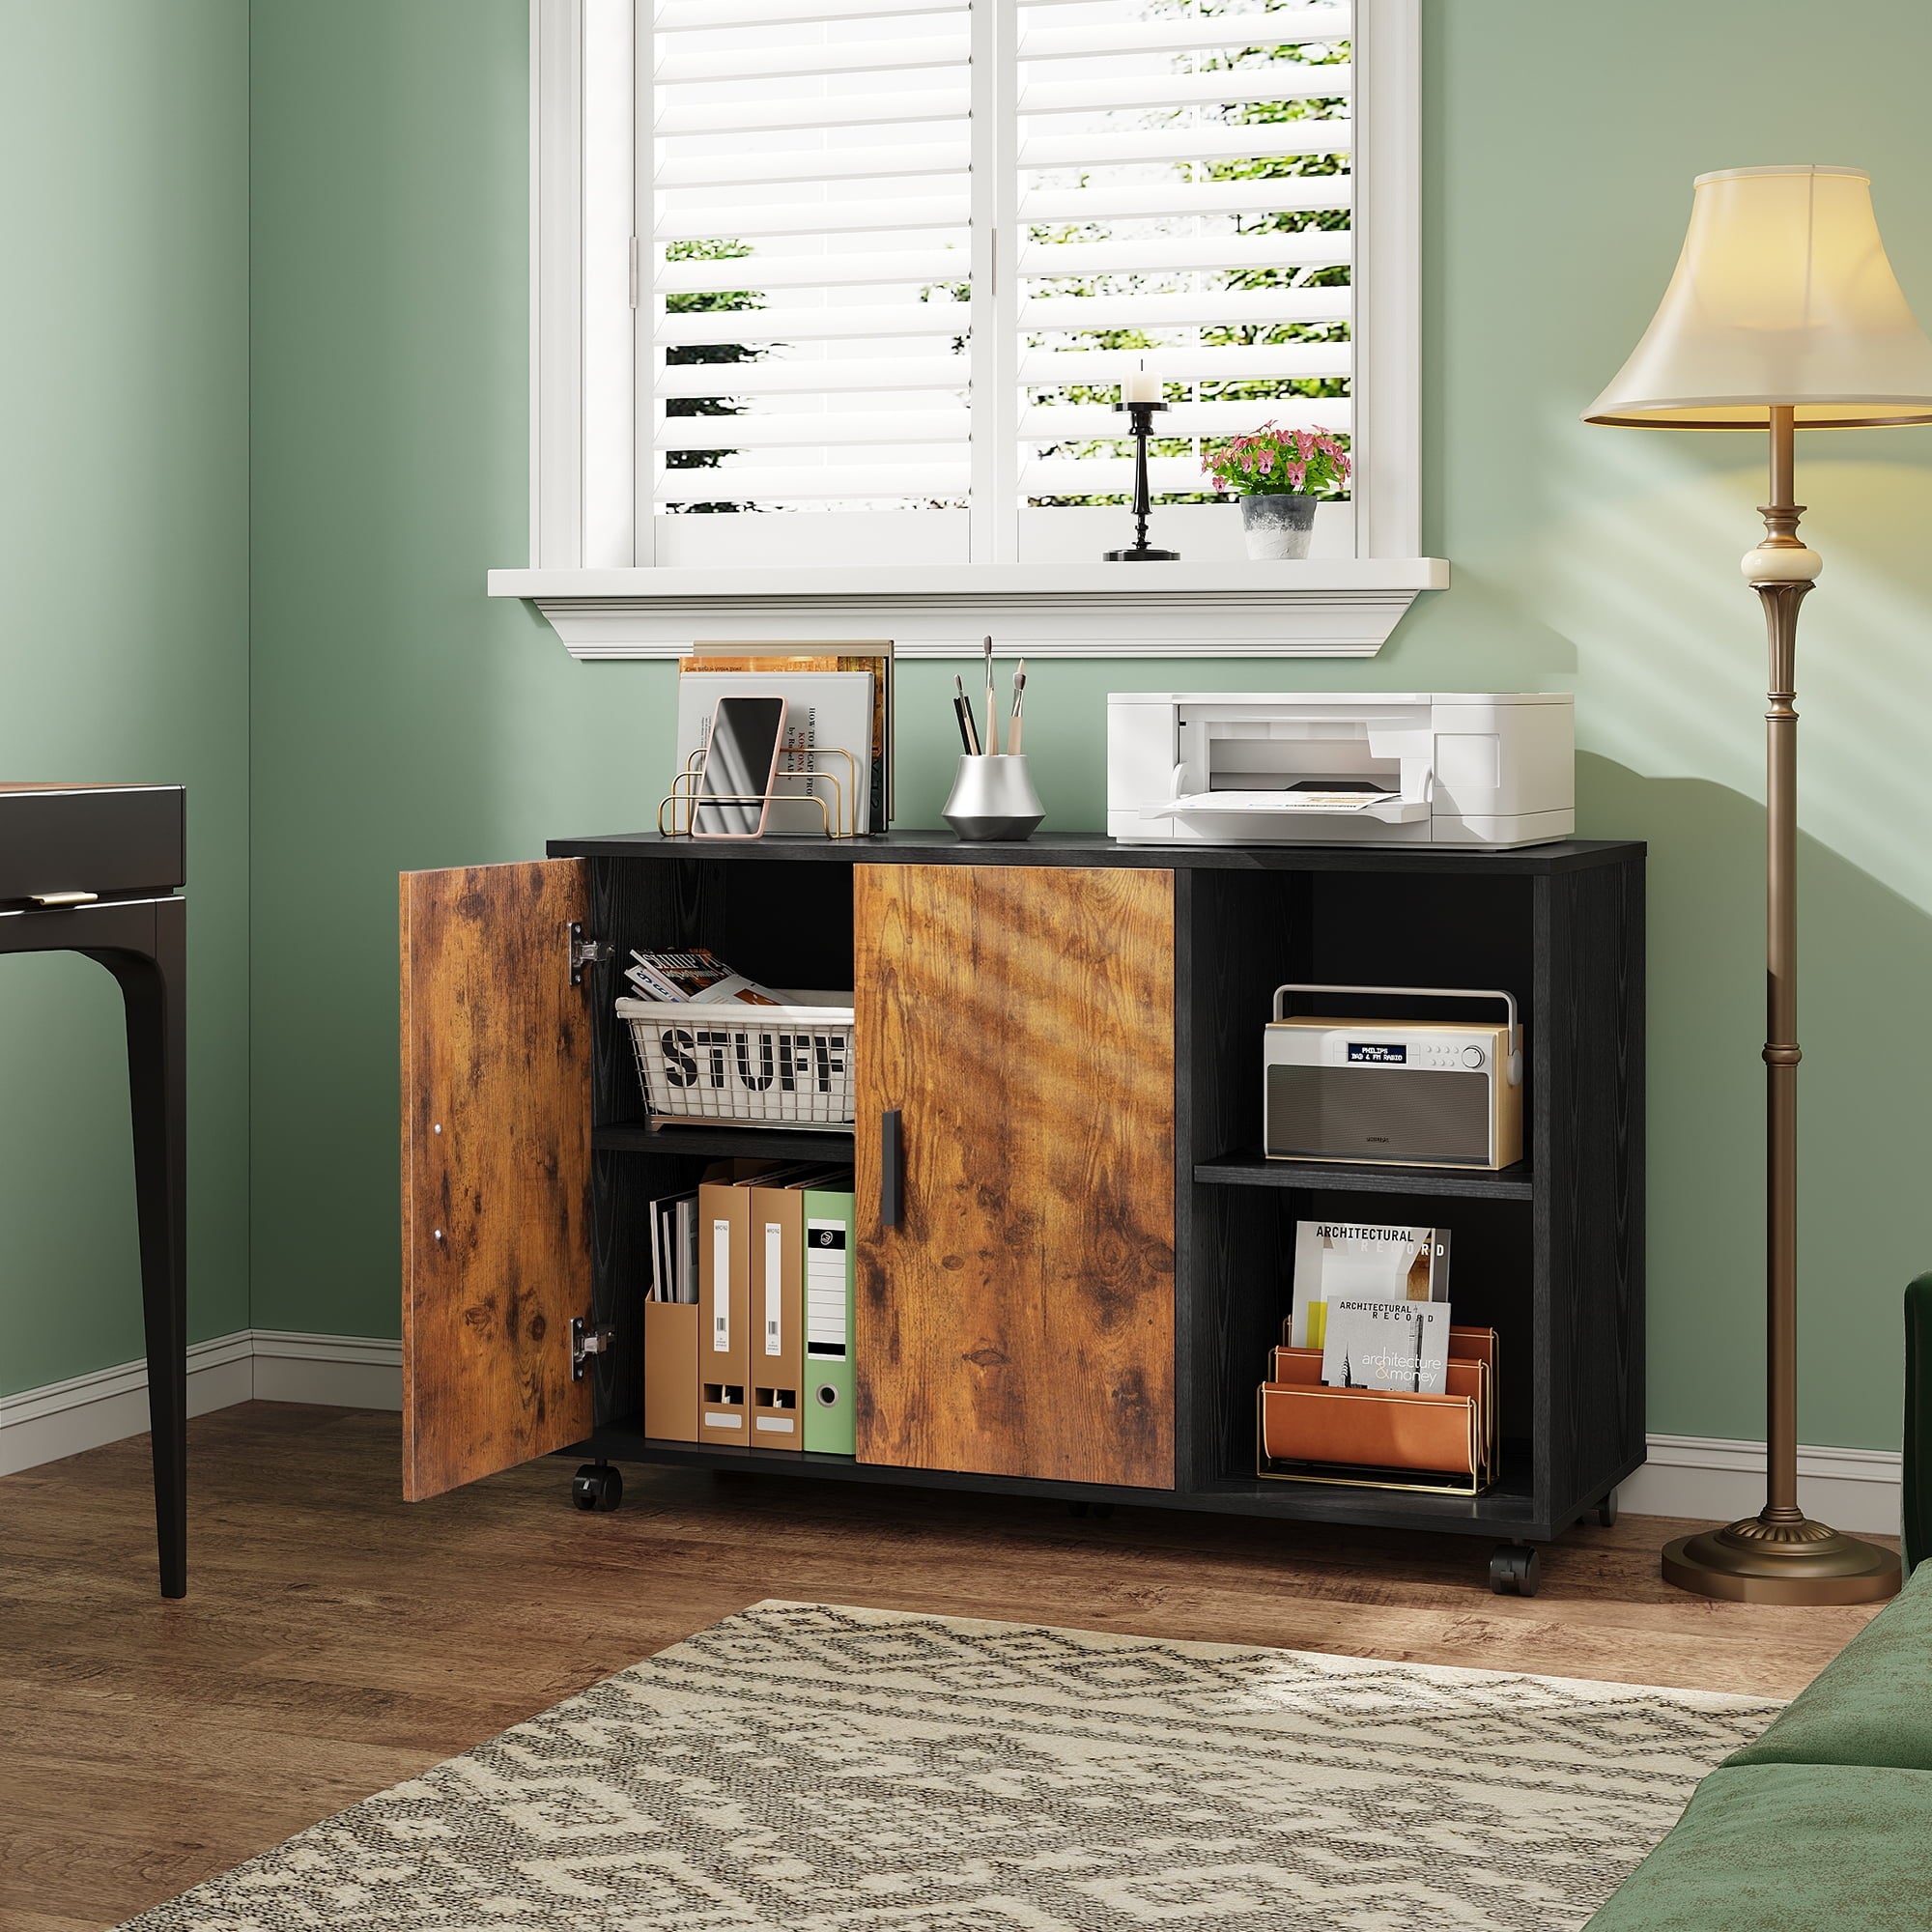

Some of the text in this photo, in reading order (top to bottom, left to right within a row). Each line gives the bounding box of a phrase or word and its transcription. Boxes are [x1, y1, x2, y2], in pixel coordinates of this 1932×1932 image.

[787, 726, 796, 736] by
[808, 730, 815, 742] TO
[662, 1029, 845, 1093] STUFF
[1316, 1226, 1414, 1242] ARCHITECTURAL
[1339, 1301, 1412, 1314] ARCHITECTURAL
[1372, 1312, 1434, 1322] RECORD
[1362, 1347, 1442, 1370] architecture
